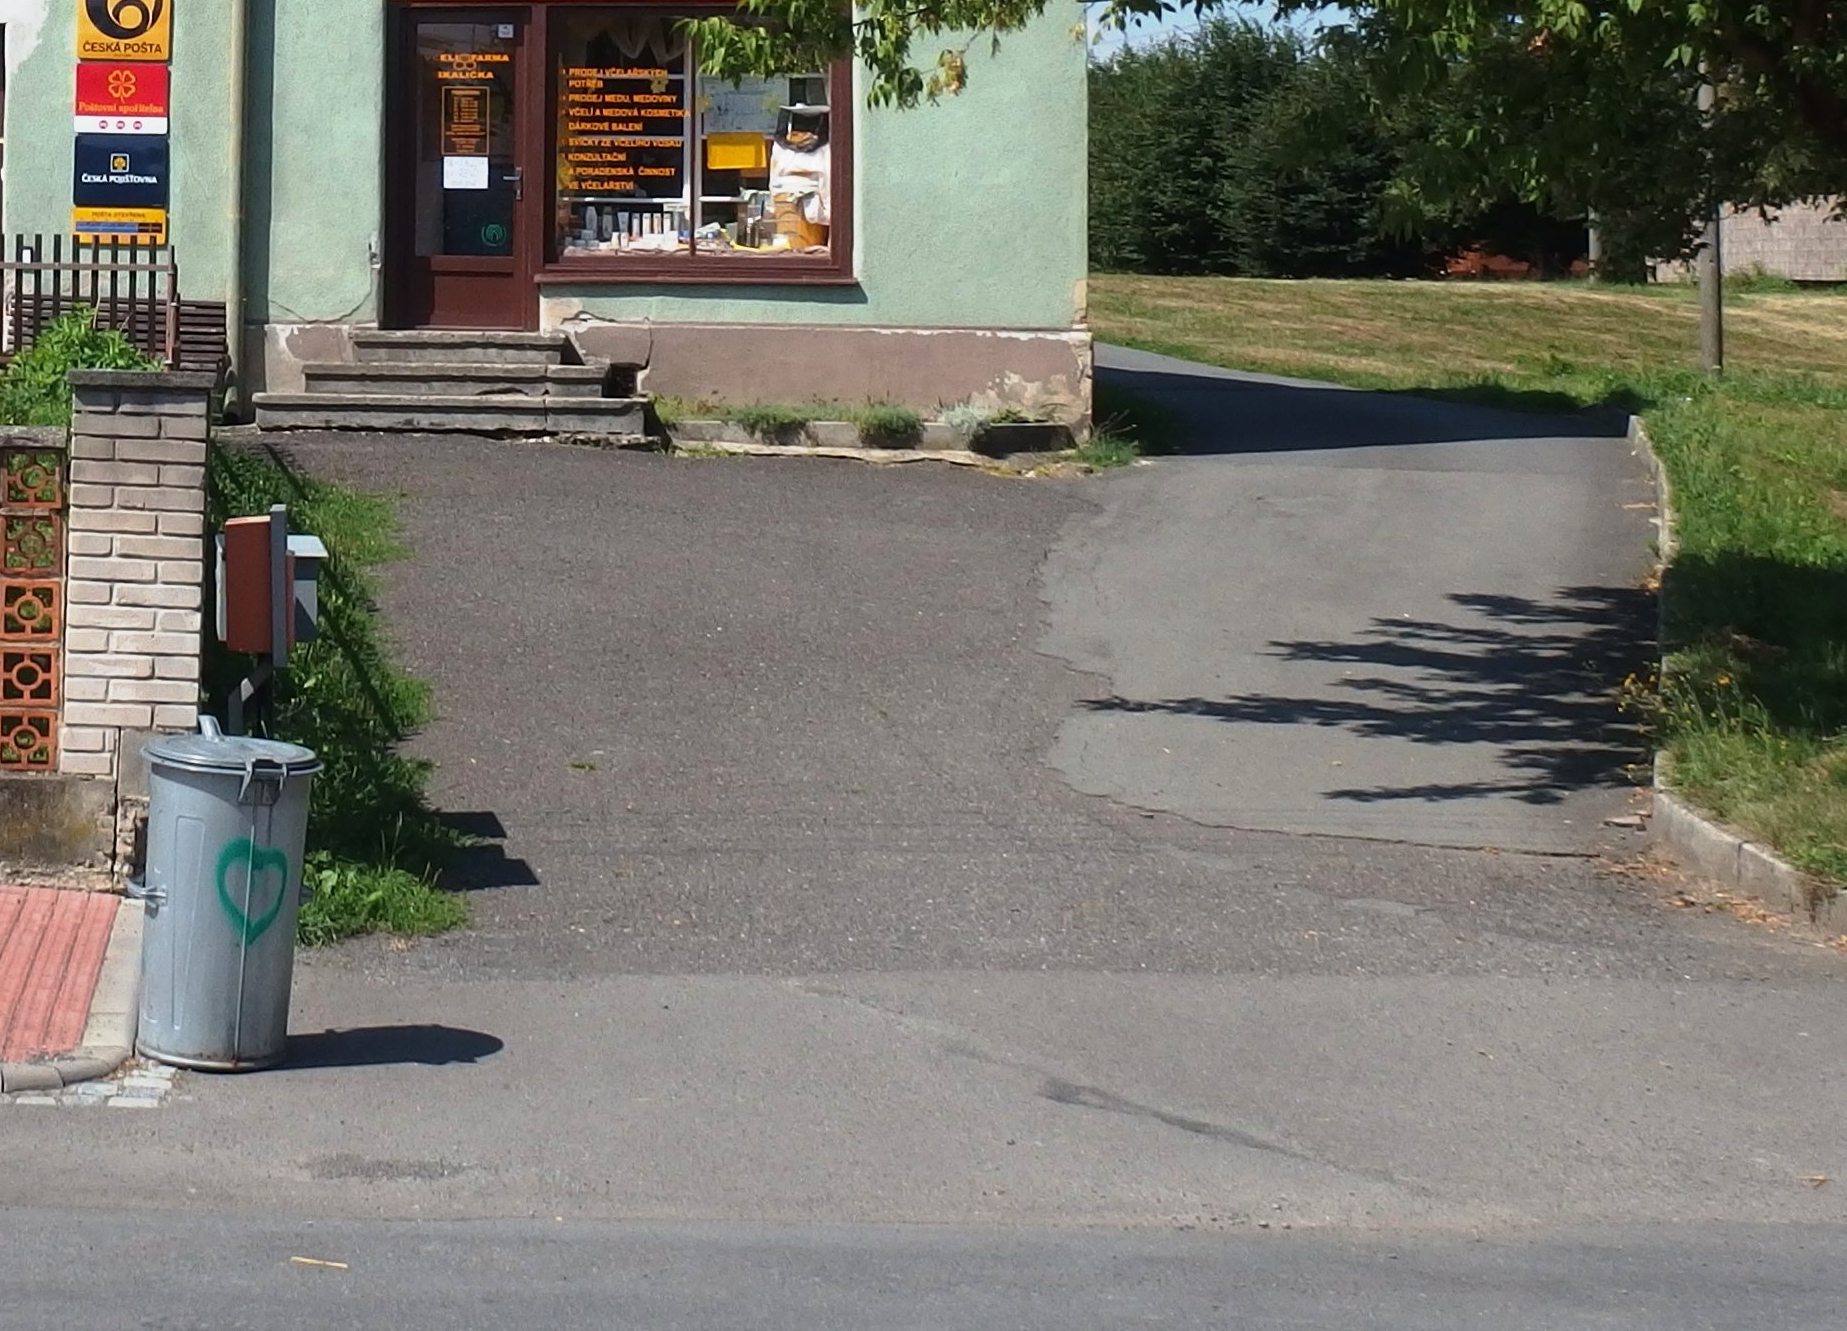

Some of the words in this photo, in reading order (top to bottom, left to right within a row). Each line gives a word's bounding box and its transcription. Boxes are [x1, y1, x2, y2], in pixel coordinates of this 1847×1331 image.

[82, 40, 122, 53] ČESKÁ
[123, 41, 163, 54] POŠTA
[470, 53, 510, 62] FARMA
[568, 67, 603, 77] PRODEJ
[568, 93, 603, 103] PRODEJ
[78, 101, 117, 112] Poštovní
[118, 103, 164, 115] spořitelna
[595, 108, 601, 117] A
[81, 173, 108, 183] ČESKÁ
